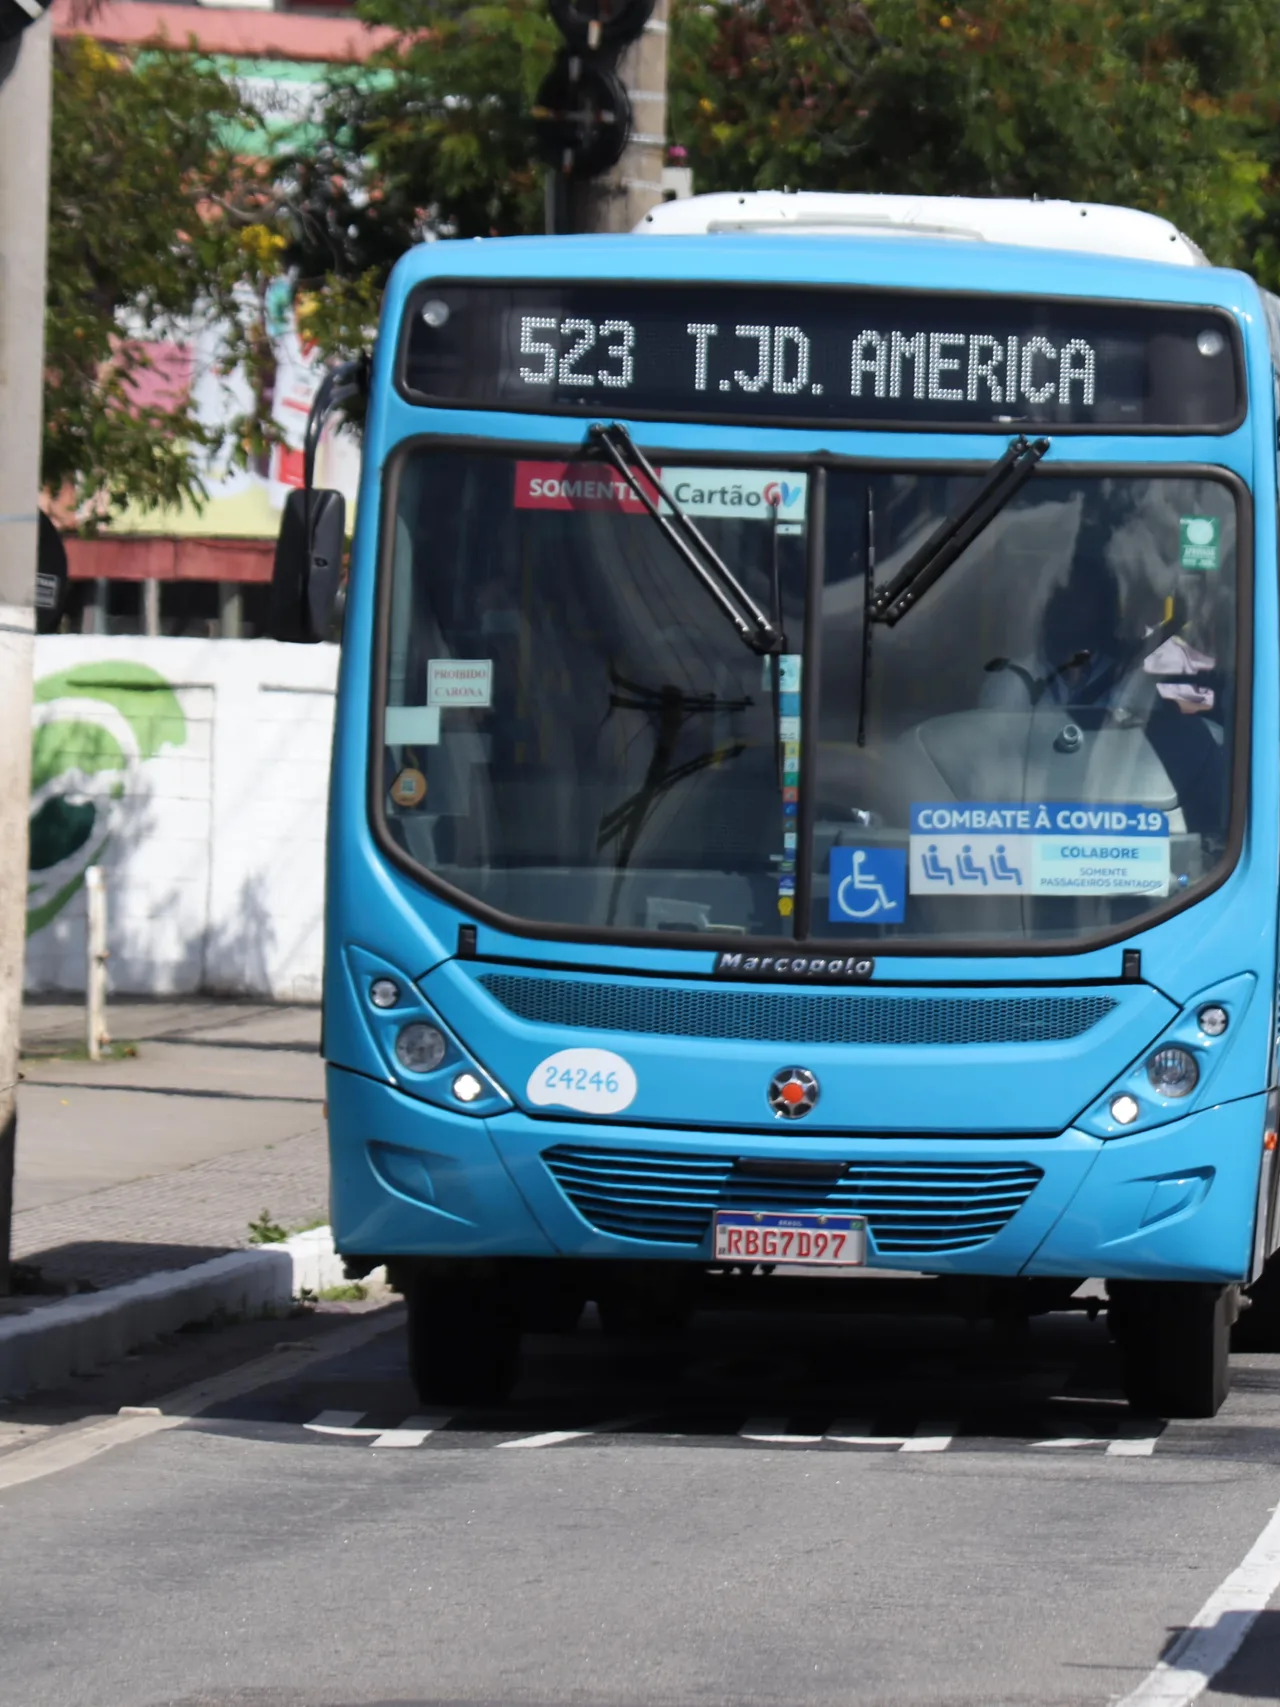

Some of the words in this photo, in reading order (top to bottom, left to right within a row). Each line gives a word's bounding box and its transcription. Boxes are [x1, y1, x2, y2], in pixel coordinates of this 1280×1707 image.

[519, 316, 636, 388] 523
[686, 322, 824, 394] T.JD.
[850, 329, 1096, 405] AMERICA
[433, 668, 487, 680] PROIBIDO
[434, 686, 484, 698] CARONA
[917, 809, 1030, 830] COMBATE
[1032, 804, 1052, 829] À
[1055, 811, 1163, 831] COVID-19
[1060, 846, 1140, 859] COLABORE
[1079, 867, 1128, 877] SOMENTE
[1040, 877, 1112, 888] PASSAGEIROS
[1112, 879, 1163, 889] SENTADOS
[719, 952, 872, 976] Marcopolo
[544, 1066, 620, 1093] 24246
[727, 1228, 848, 1259] RBG7D97
